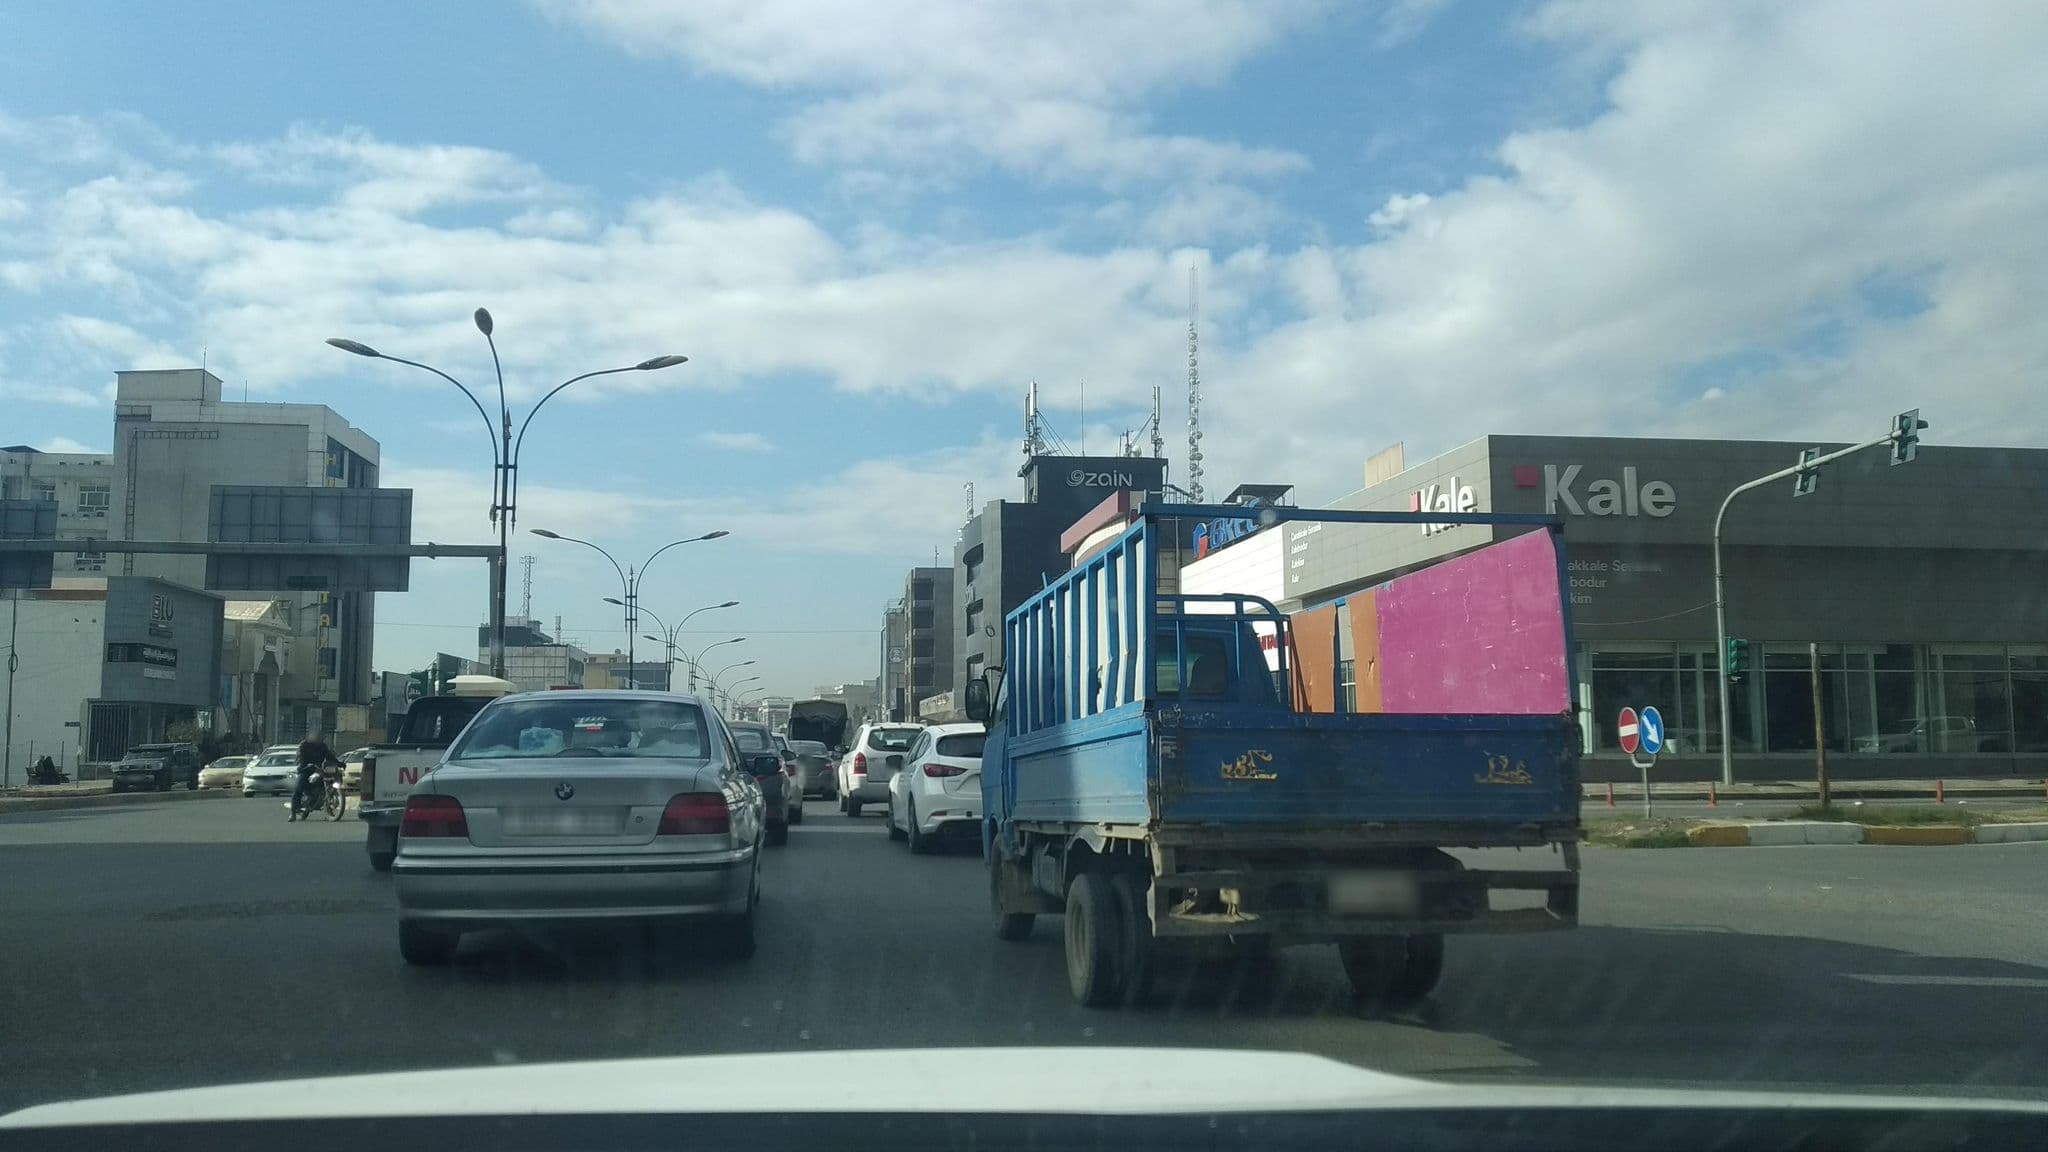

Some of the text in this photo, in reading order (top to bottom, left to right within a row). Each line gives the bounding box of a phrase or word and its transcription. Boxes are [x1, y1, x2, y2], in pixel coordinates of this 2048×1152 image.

[1084, 469, 1133, 487] zain
[1544, 465, 1676, 517] Kale
[1567, 559, 1609, 572] akkale
[1569, 575, 1608, 588] bodur
[1569, 592, 1593, 605] kim
